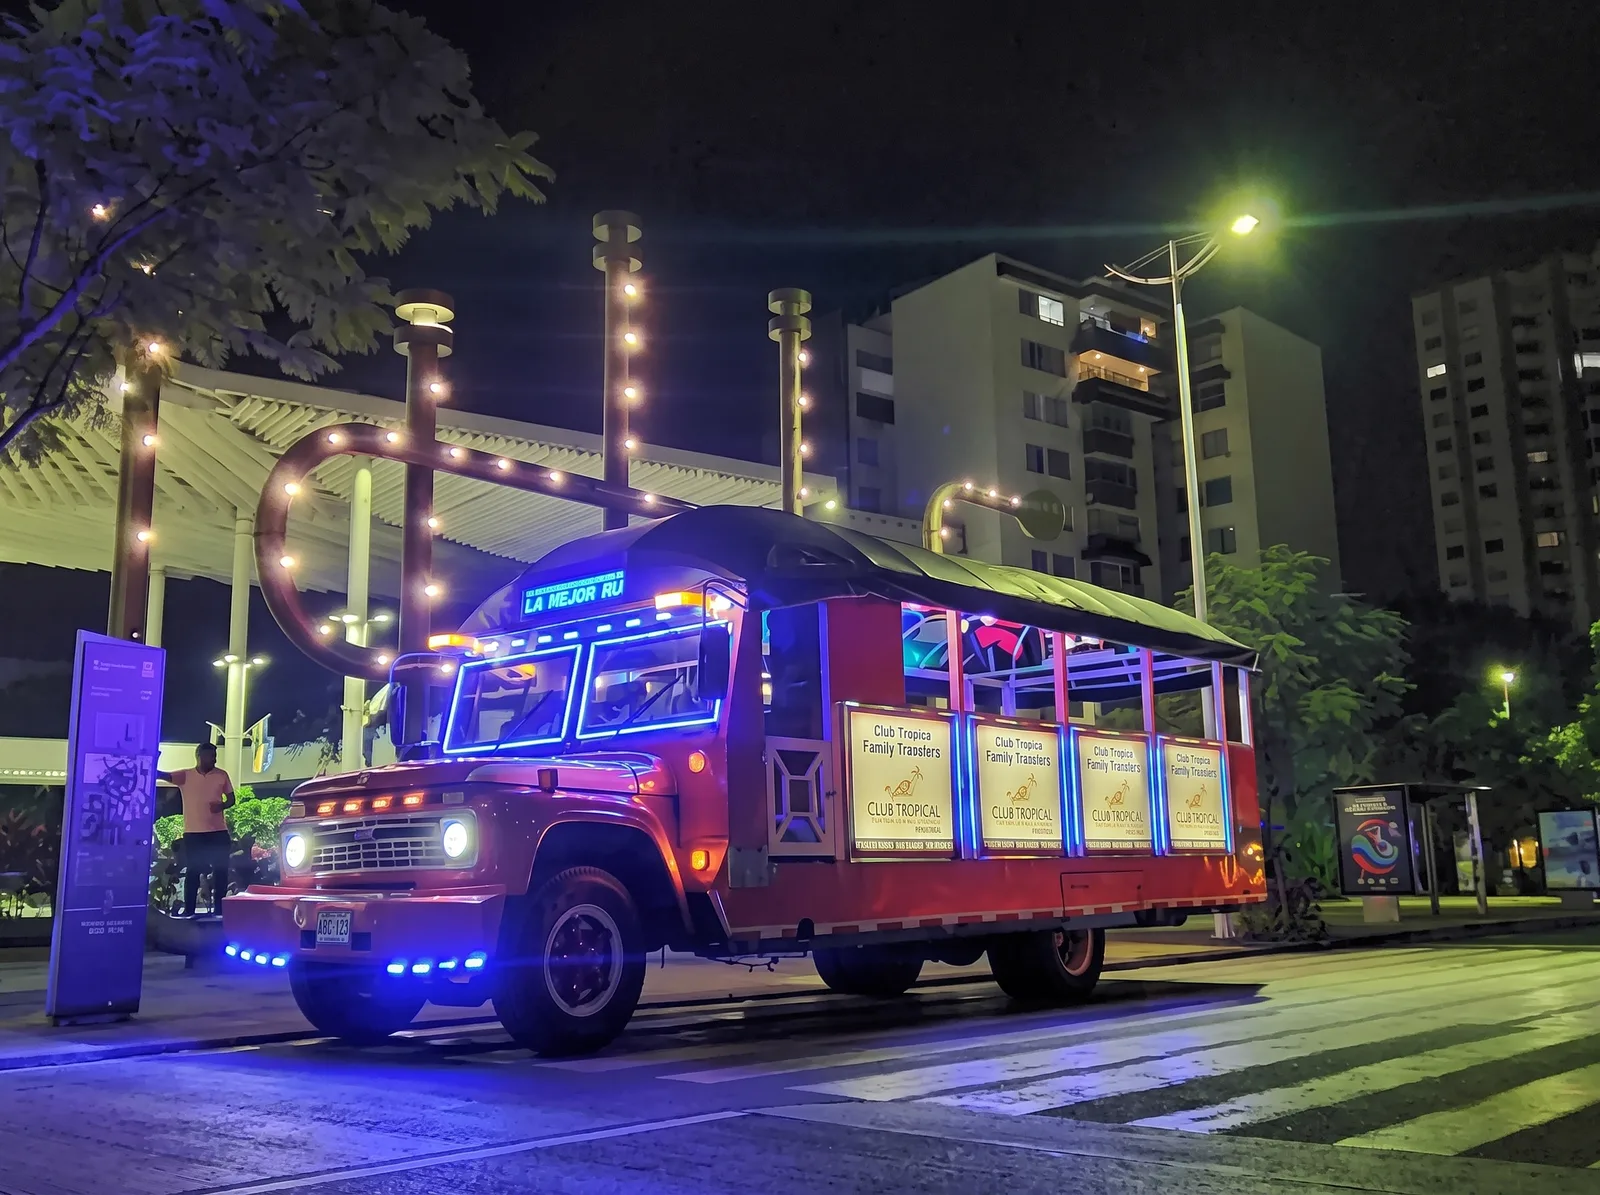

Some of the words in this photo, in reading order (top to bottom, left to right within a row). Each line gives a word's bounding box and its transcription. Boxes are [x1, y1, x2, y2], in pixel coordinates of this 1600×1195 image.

[525, 596, 543, 614] LA
[548, 585, 596, 609] MEJOR
[601, 579, 624, 599] RU
[874, 724, 895, 738] Club
[898, 726, 931, 741] Tropica
[863, 739, 895, 758] Family
[995, 736, 1014, 748] Club
[1015, 738, 1043, 751] Tropica
[986, 750, 1013, 767] Family
[1094, 745, 1109, 757] Club
[1110, 747, 1134, 760] Tropica
[1087, 758, 1109, 773] Family
[867, 801, 894, 817] CLUB
[896, 803, 941, 818] TROPICAL
[991, 805, 1014, 819] CLUB
[1015, 807, 1053, 821] TROPICAL
[1112, 810, 1144, 823] TROPICAL
[1175, 811, 1191, 824] CLUB
